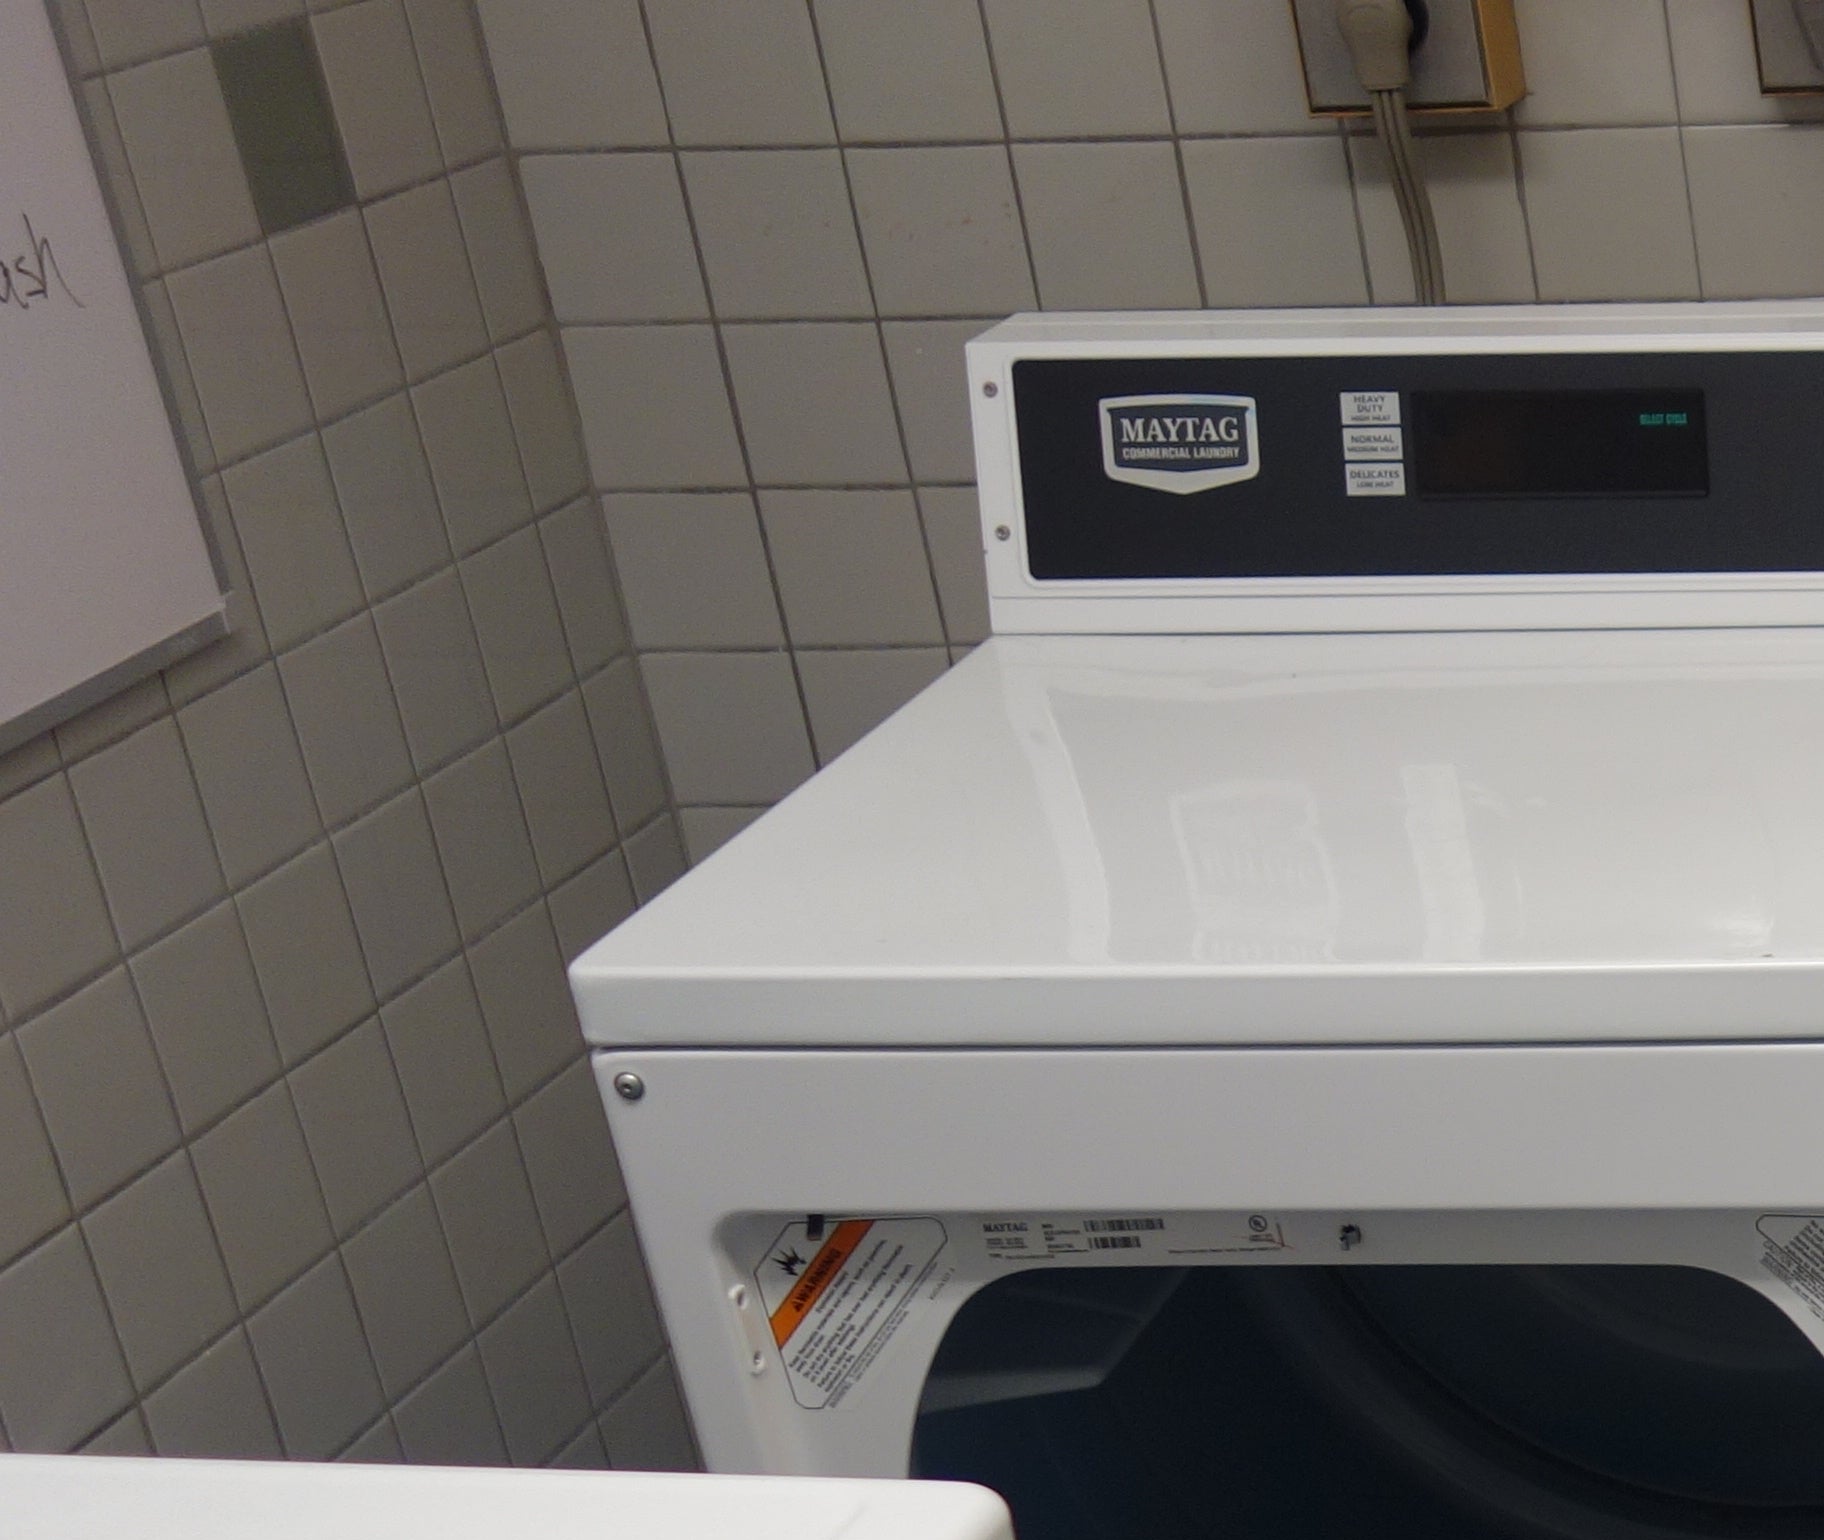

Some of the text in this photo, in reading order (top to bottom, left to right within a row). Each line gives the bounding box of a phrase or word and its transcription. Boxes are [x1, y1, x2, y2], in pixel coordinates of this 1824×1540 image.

[1353, 395, 1385, 403] HEAVY
[1357, 404, 1383, 413] DUTY
[1120, 416, 1239, 443] MAYTAG
[1351, 434, 1394, 443] NORMAL
[1122, 446, 1240, 460] COMMERCIAL LAUNDRY
[1350, 470, 1400, 479] DELICATES
[796, 1247, 841, 1303] WARNING
